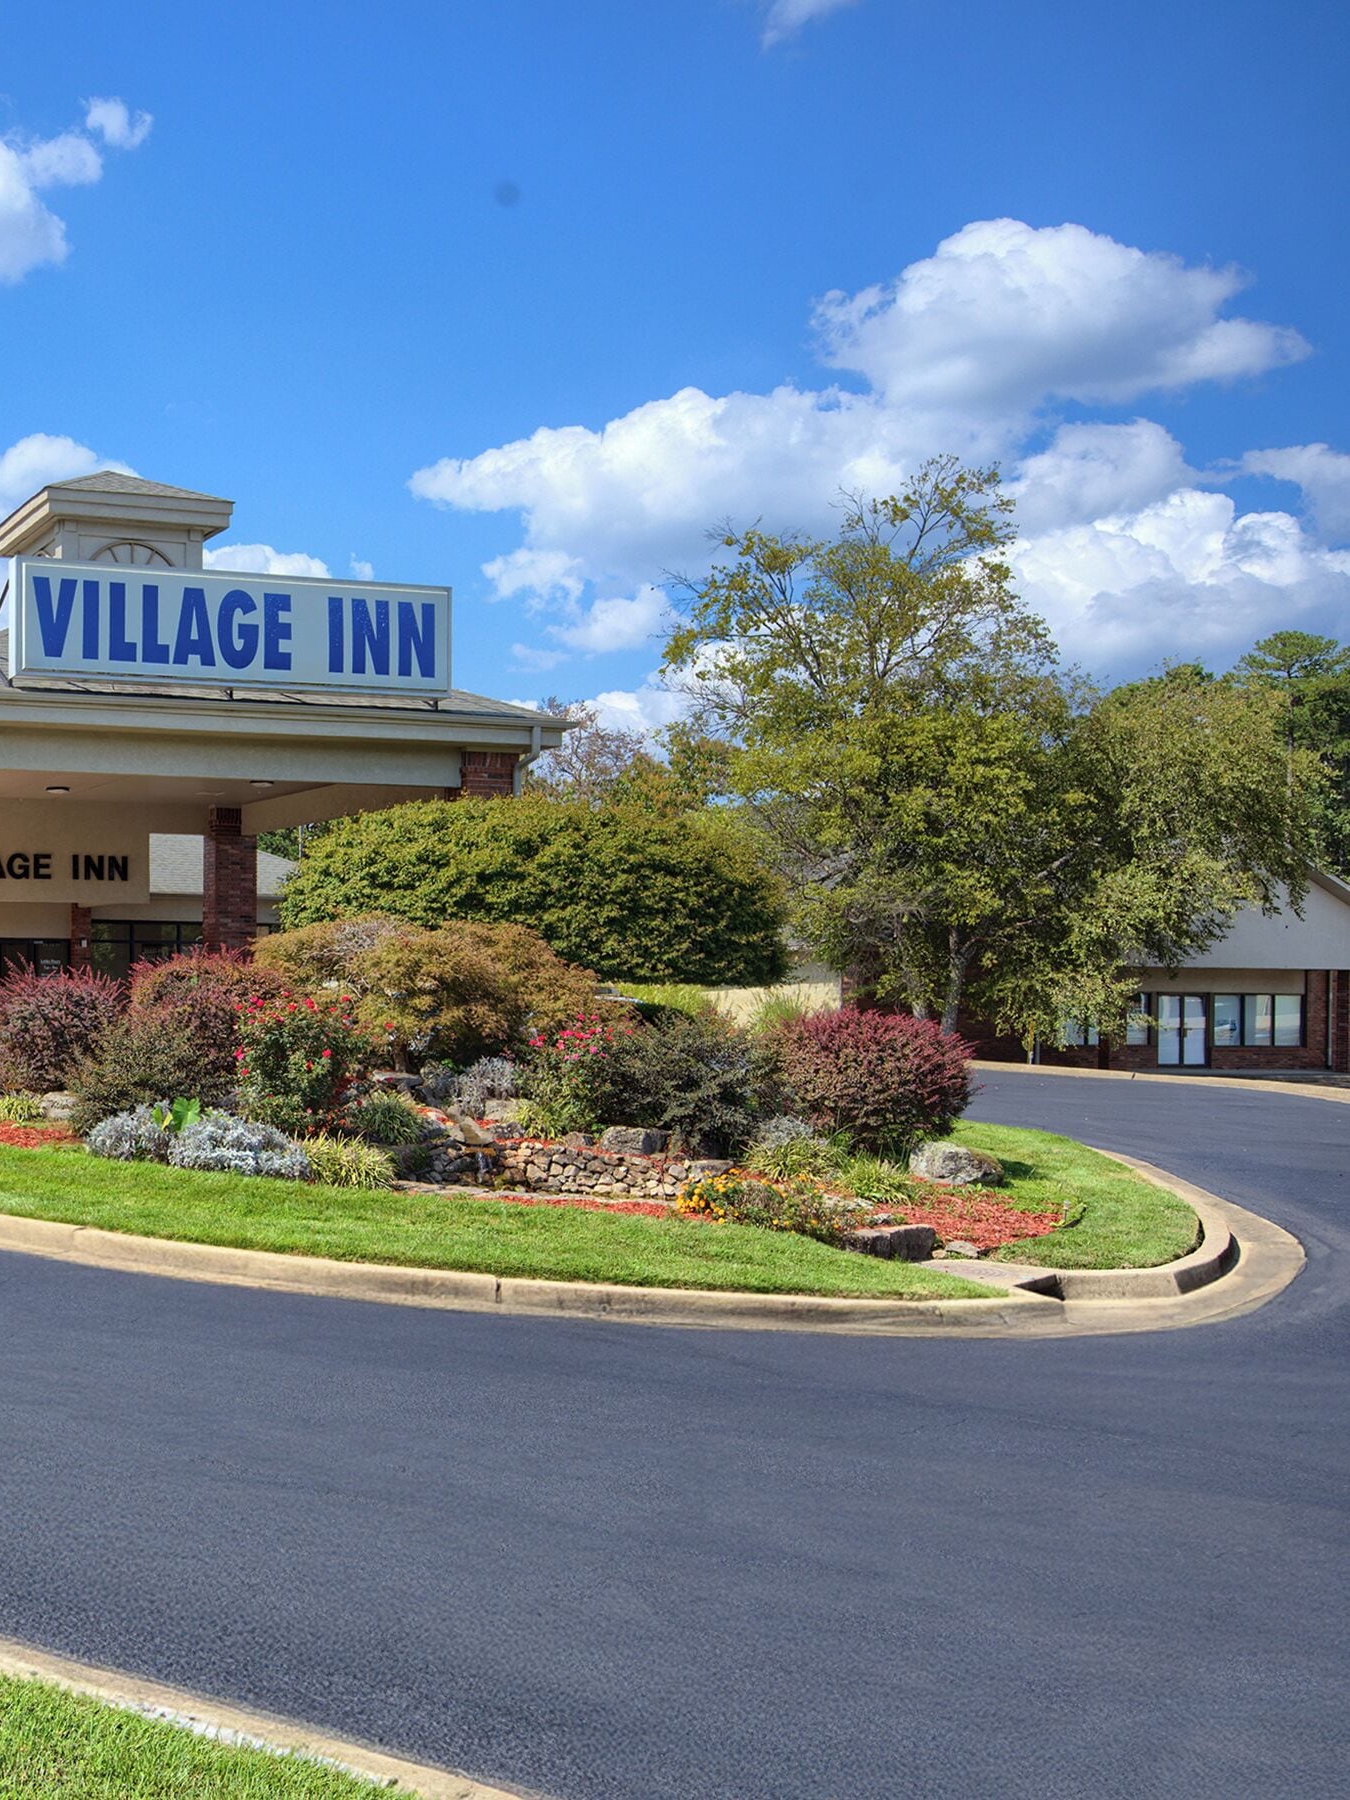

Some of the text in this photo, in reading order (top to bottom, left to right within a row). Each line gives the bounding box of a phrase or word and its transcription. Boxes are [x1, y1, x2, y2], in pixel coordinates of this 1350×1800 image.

[32, 575, 436, 678] VILLAGE INN
[71, 854, 129, 881] INN
